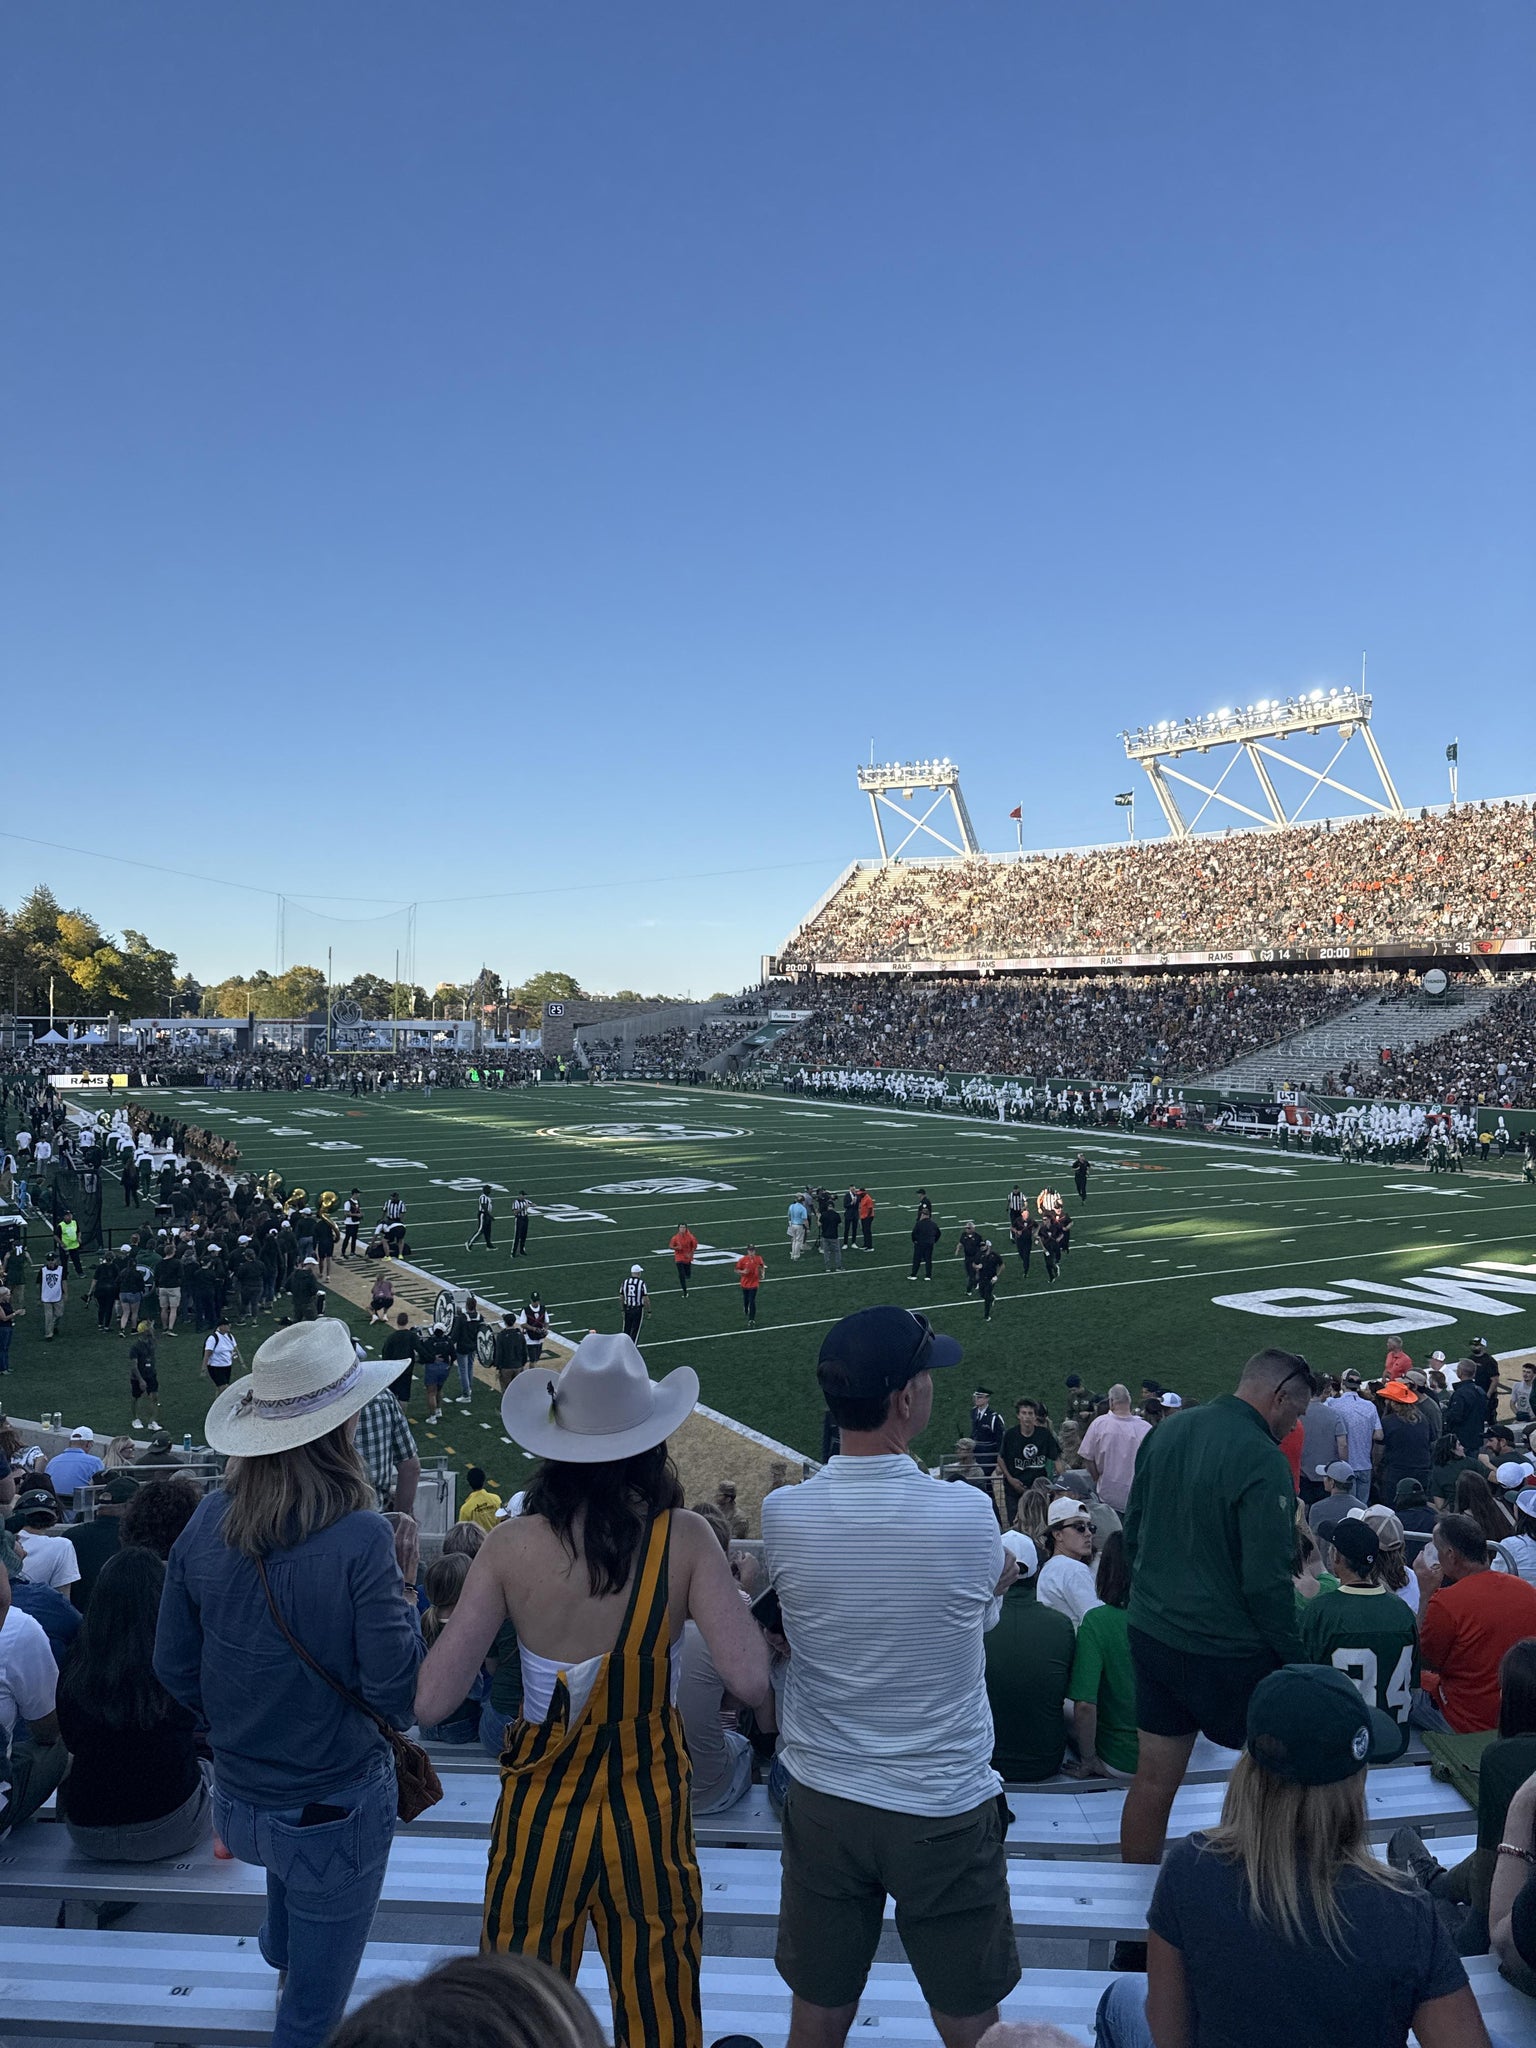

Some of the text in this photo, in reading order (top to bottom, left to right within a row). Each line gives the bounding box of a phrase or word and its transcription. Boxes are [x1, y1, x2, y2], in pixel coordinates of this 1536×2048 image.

[1356, 947, 1374, 957] half
[1455, 942, 1471, 953] 35
[1207, 952, 1234, 961] RAMS
[1279, 949, 1291, 960] 14
[1319, 947, 1350, 959] 20:00
[1100, 957, 1123, 966] RAMS
[785, 964, 808, 972] 20:00
[892, 963, 912, 971] RAMS
[551, 1005, 562, 1014] 25
[627, 1284, 636, 1297] R
[171, 1986, 190, 1996] 10
[863, 2017, 872, 2026] 7
